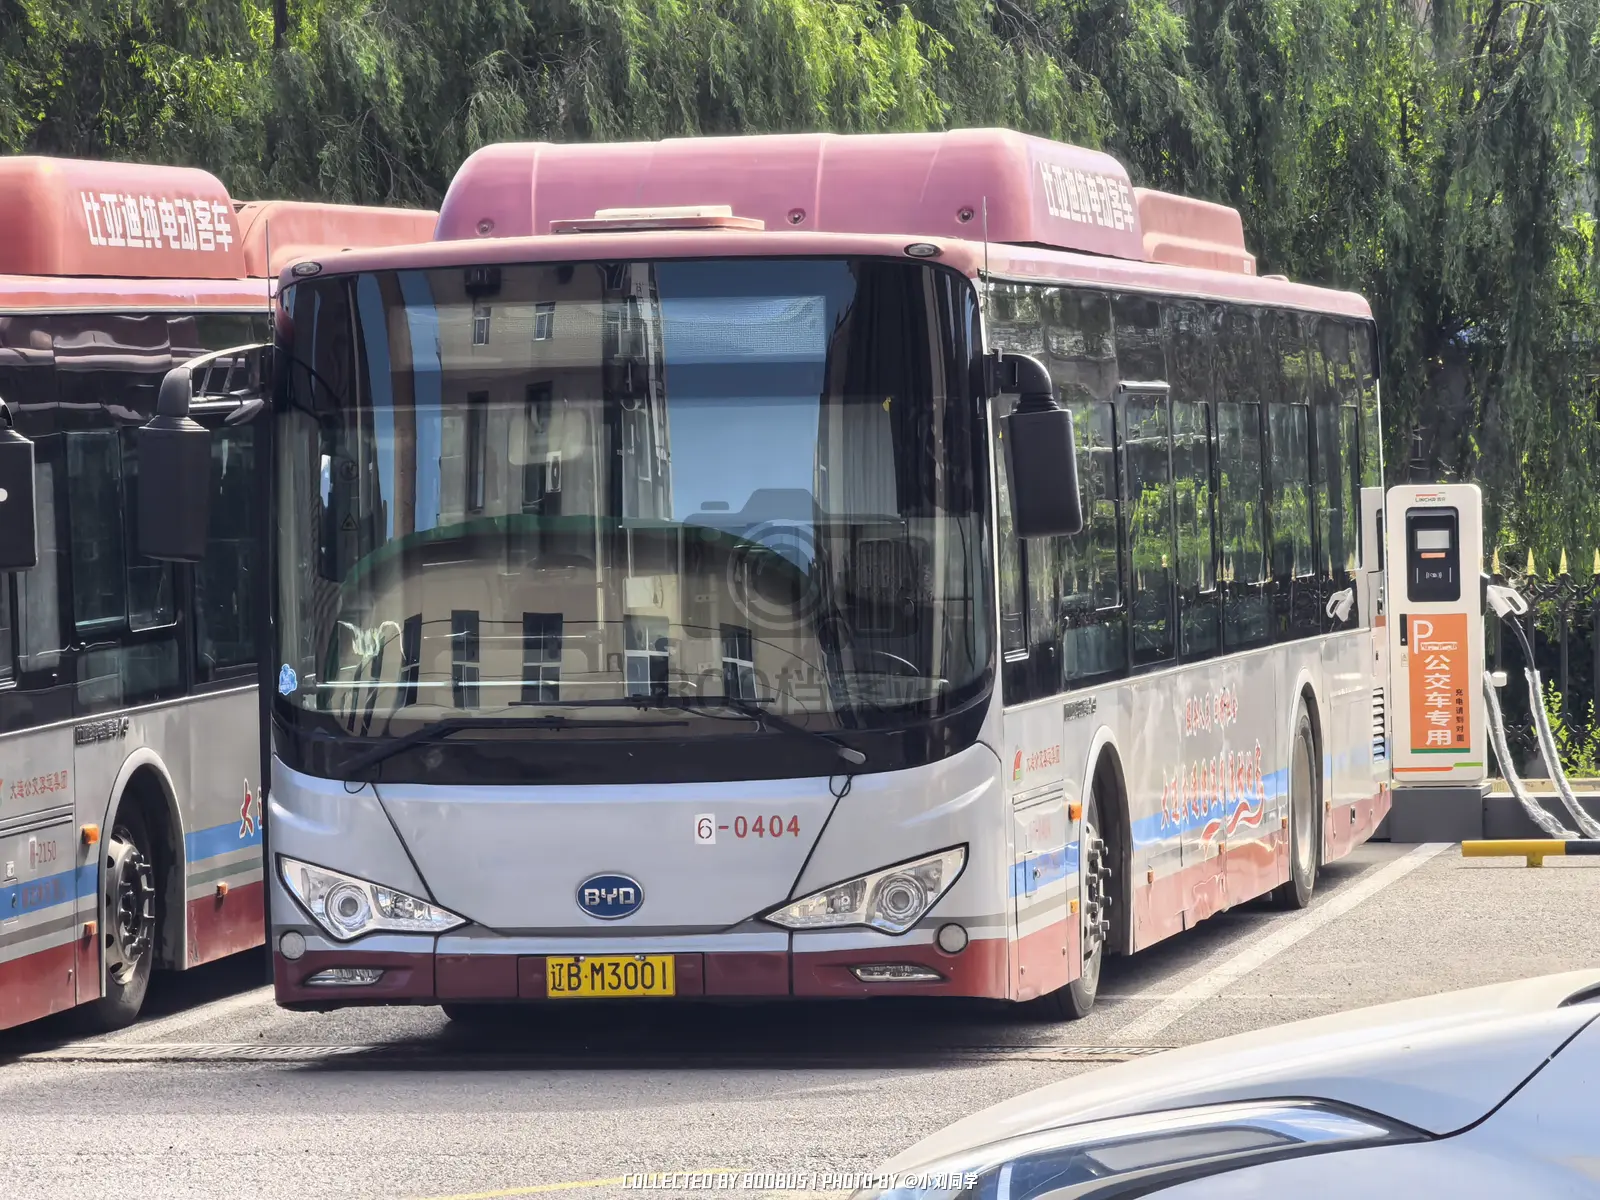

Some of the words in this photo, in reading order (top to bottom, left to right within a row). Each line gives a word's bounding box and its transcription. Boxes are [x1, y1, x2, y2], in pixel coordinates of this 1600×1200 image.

[1038, 161, 1135, 233] 比亚迪纯电动客车
[80, 191, 233, 252] 比亚迪纯电动客车
[1413, 620, 1434, 655] P
[1424, 654, 1452, 746] 公交车专用
[696, 814, 801, 842] 6-0404
[584, 887, 635, 906] BYD
